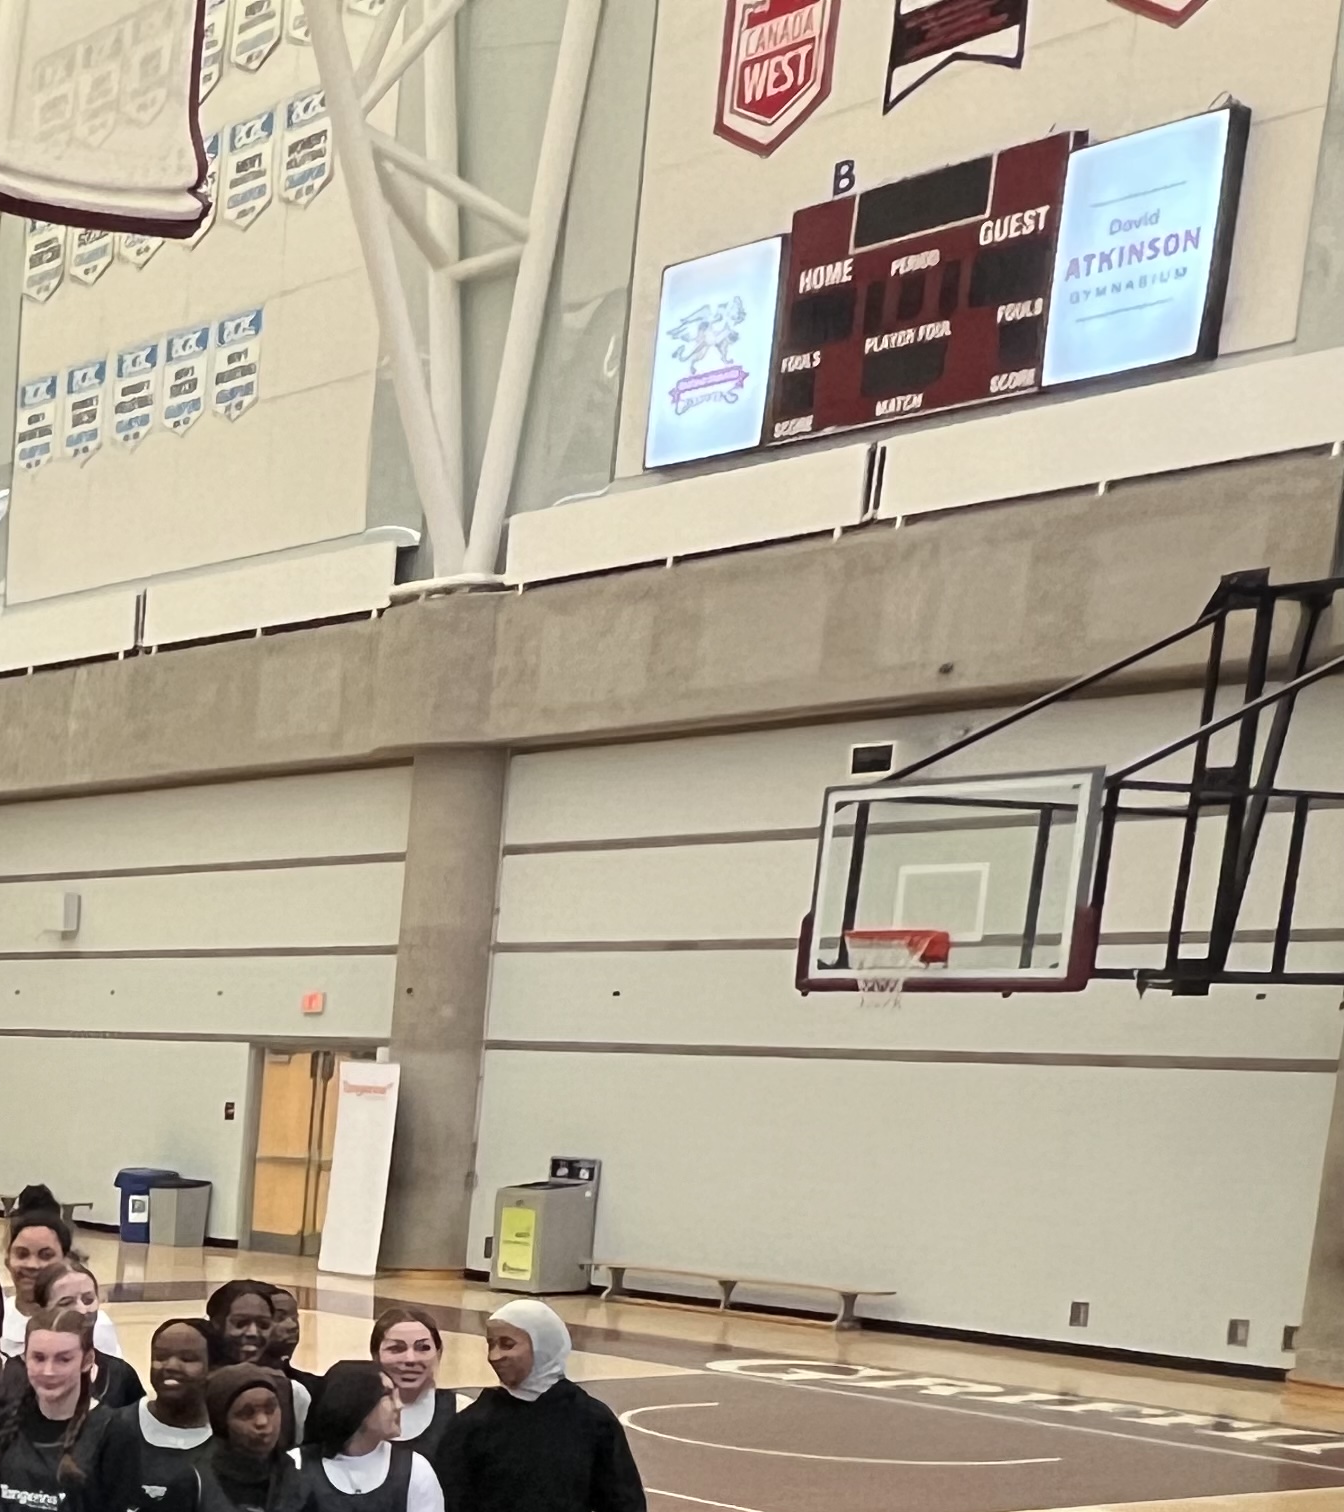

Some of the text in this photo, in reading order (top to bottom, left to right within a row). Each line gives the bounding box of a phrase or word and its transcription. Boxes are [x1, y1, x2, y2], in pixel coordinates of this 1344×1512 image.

[743, 8, 814, 56] CANADA
[742, 43, 813, 104] WEST
[832, 160, 856, 195] B
[978, 205, 1050, 247] GUEST
[1108, 208, 1161, 236] David
[1064, 226, 1202, 282] ATKINSON
[798, 257, 854, 294] HOME
[0, 1483, 58, 1505] Tangerine
